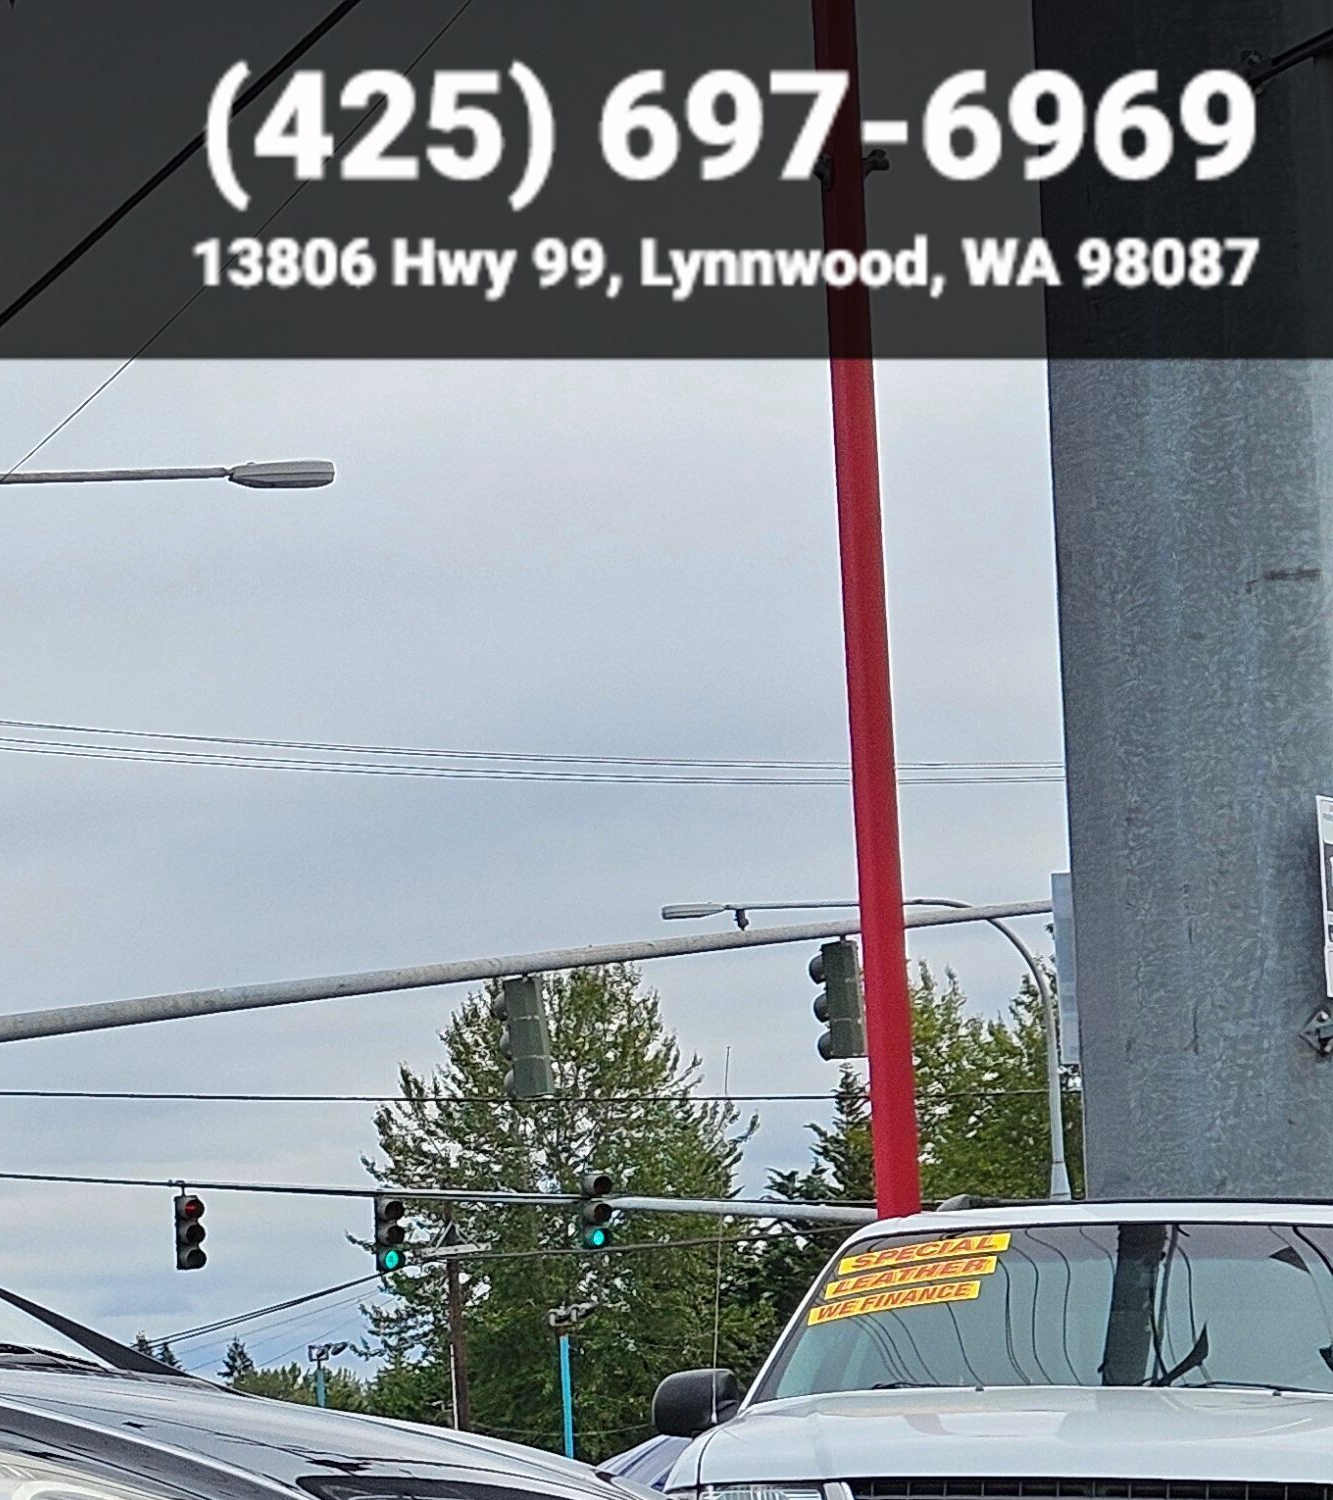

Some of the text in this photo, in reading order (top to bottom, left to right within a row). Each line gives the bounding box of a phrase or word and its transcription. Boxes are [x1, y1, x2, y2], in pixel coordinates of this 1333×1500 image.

[851, 1236, 997, 1268] SPECIAL
[833, 1258, 990, 1295] LEATHER
[817, 1283, 971, 1321] WE FINANCE
